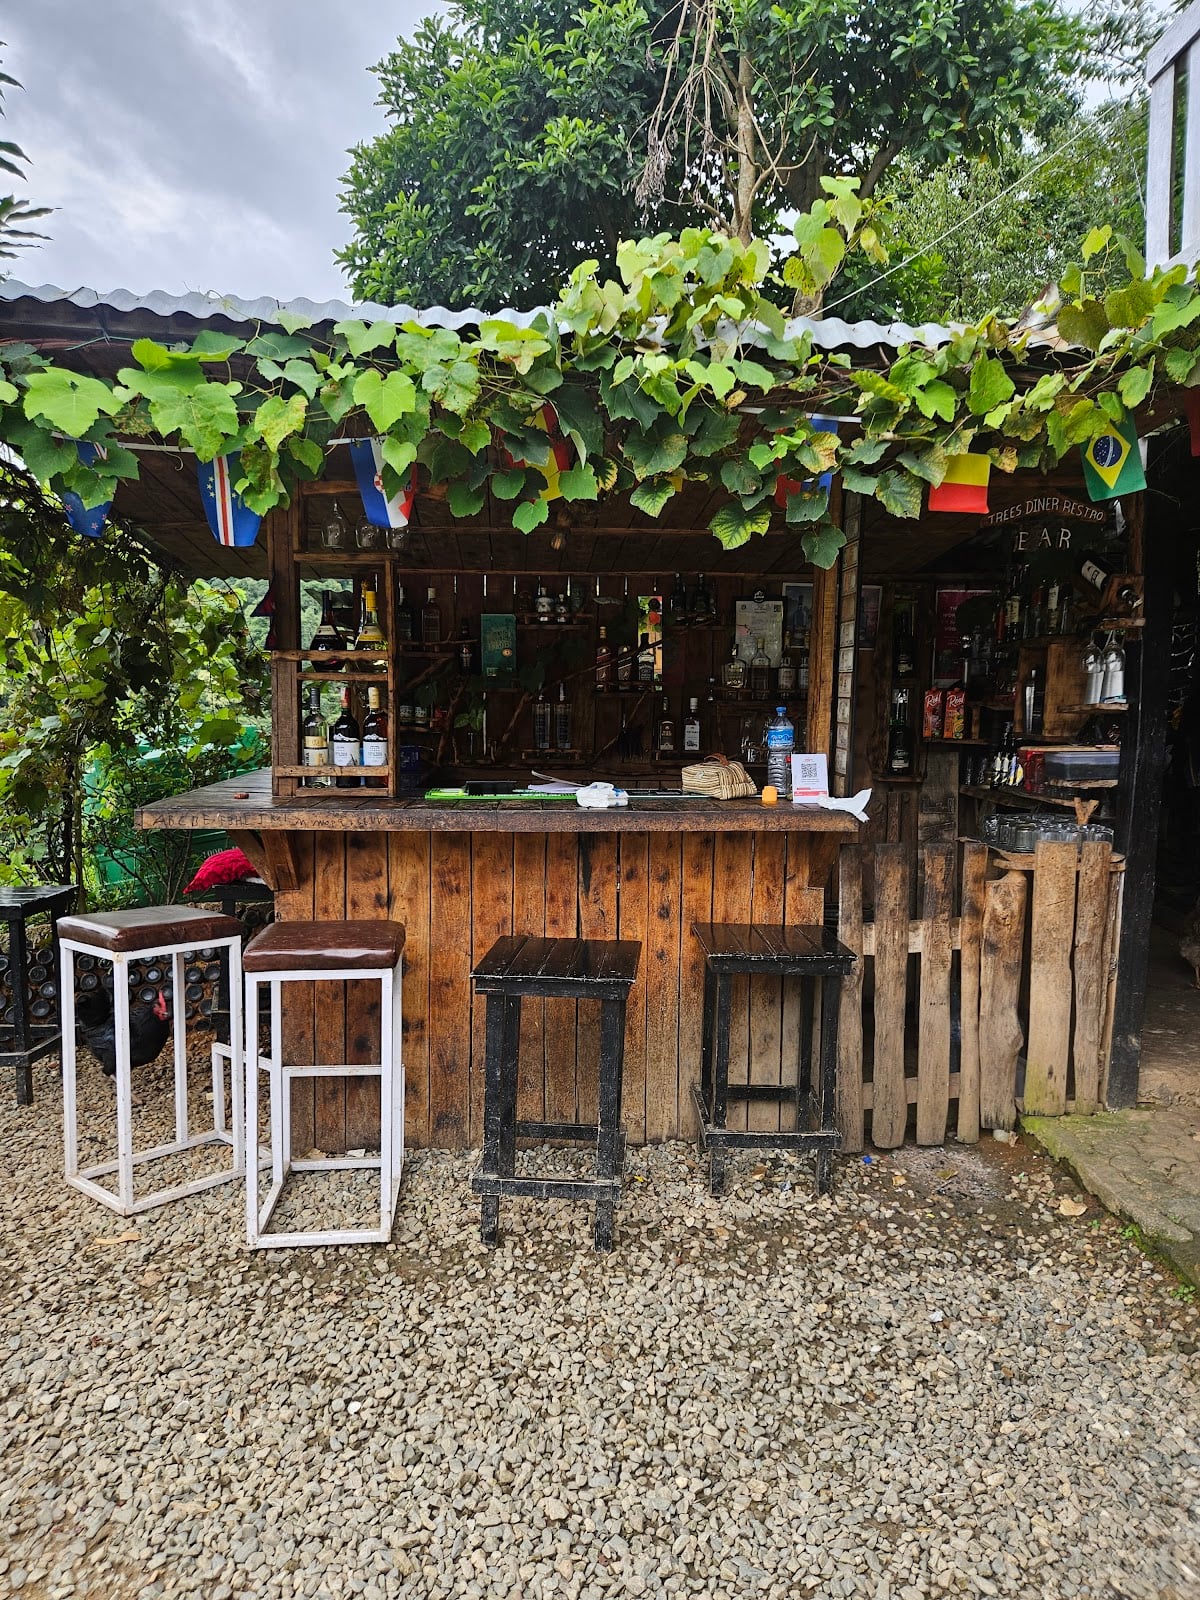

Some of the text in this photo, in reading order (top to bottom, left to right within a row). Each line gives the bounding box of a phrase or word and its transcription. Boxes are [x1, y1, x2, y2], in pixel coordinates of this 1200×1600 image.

[988, 497, 1104, 524] TREES DINER RESTRO
